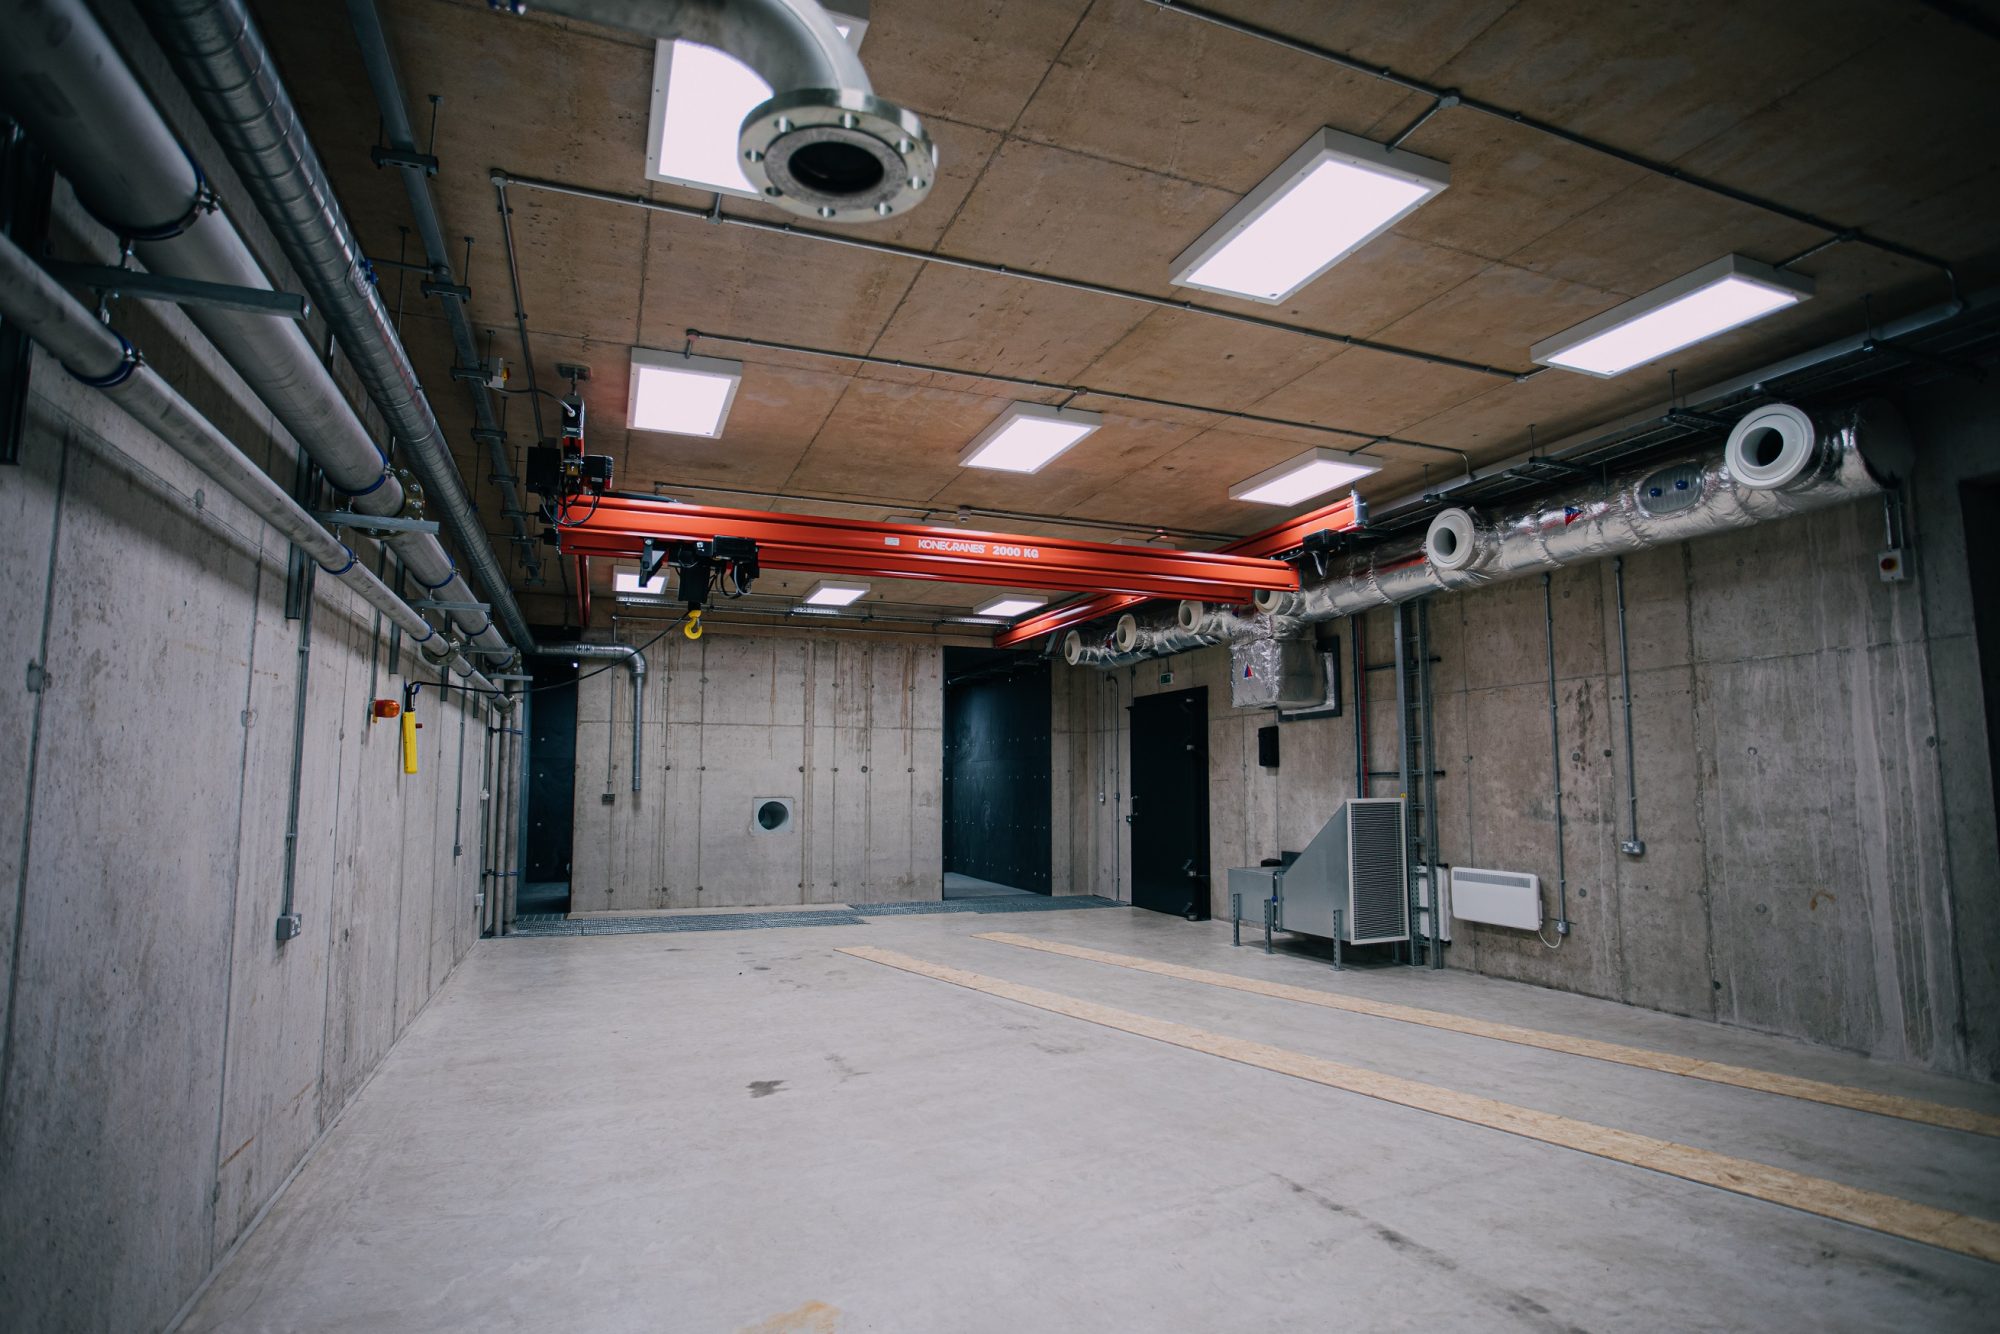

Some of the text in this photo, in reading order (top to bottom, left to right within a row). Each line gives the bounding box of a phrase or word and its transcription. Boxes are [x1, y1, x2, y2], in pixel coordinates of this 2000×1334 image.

[918, 539, 1039, 559] KONECRANES 2000 KG
